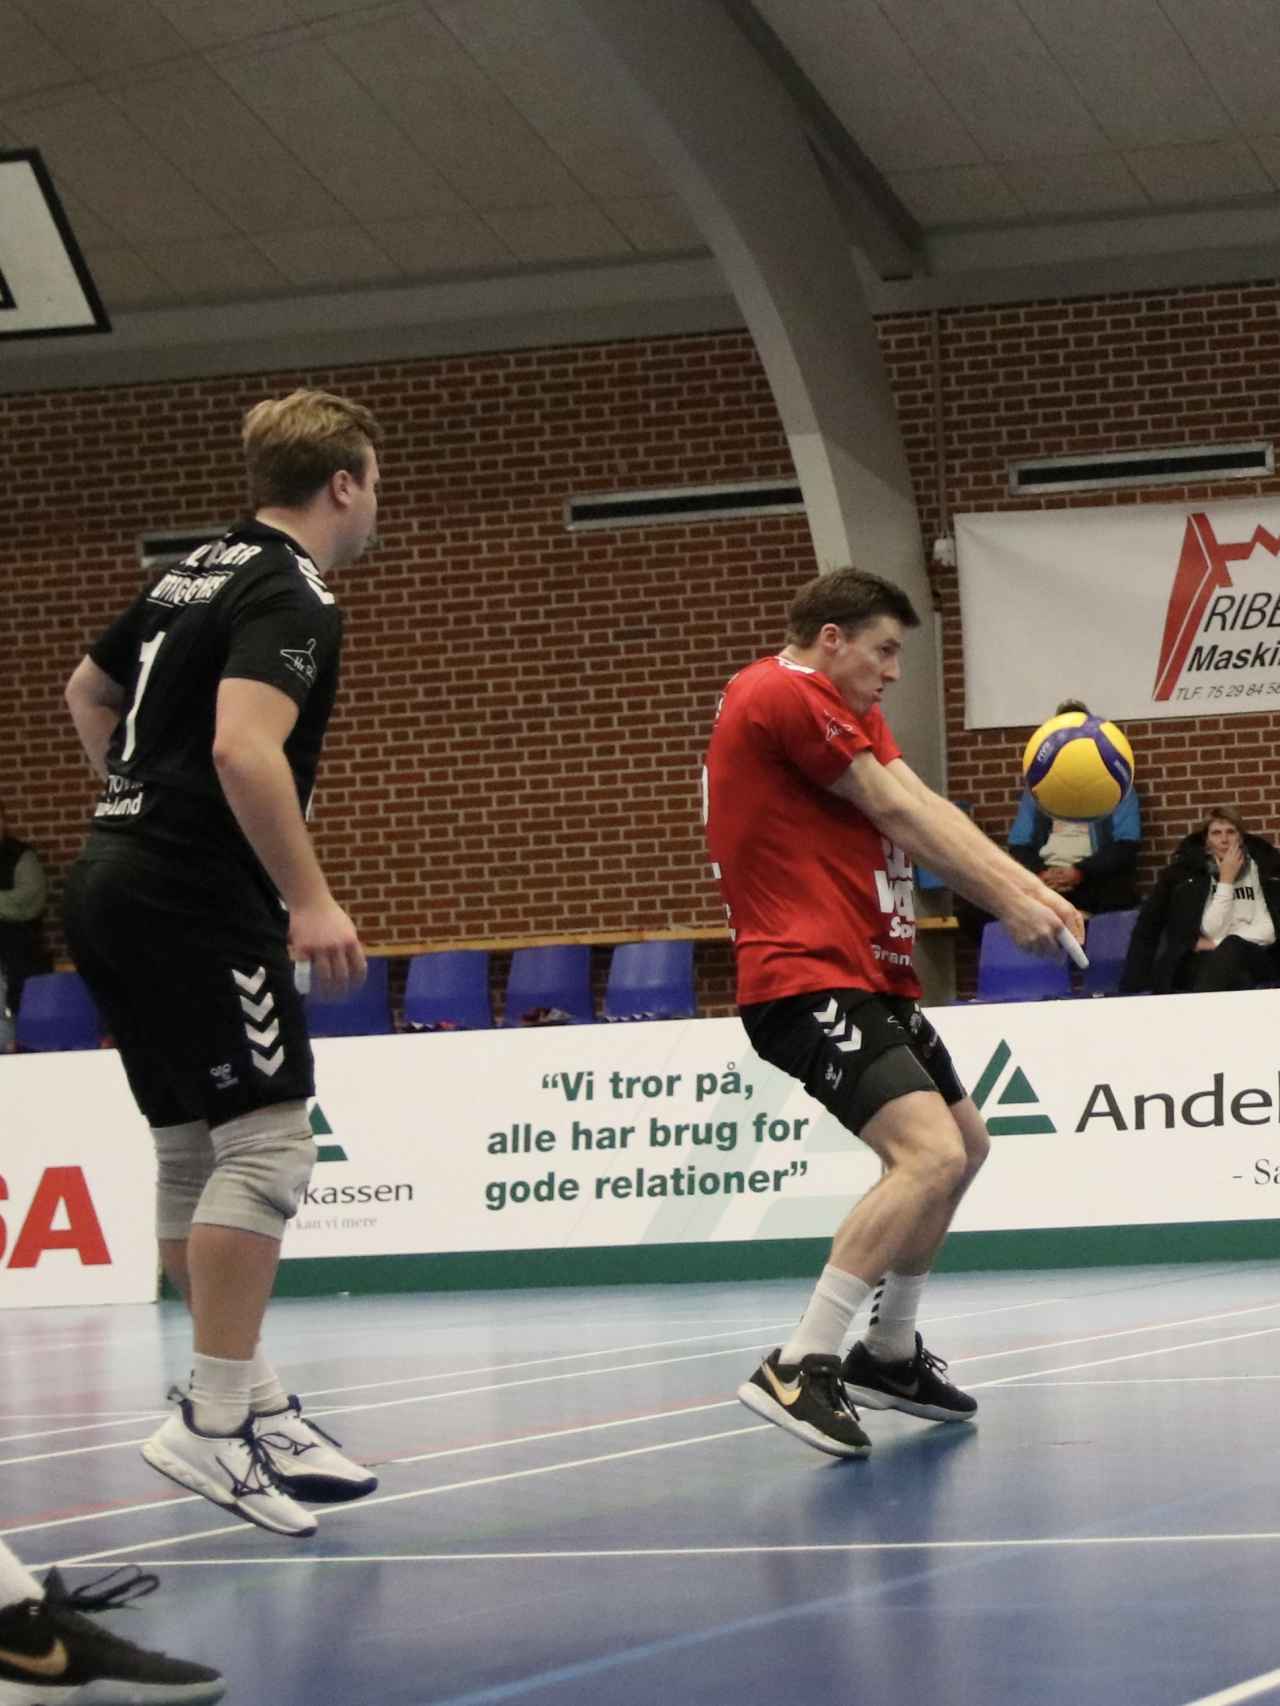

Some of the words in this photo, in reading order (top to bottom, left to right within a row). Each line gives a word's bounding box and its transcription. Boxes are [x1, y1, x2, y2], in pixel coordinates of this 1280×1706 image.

[121, 630, 167, 763] 1
[608, 1071, 682, 1100] tror
[696, 1061, 754, 1103] på,
[487, 1123, 557, 1155] alle
[570, 1121, 636, 1151] har
[649, 1117, 738, 1152] brug
[752, 1112, 810, 1143] for
[484, 1171, 580, 1212] gode
